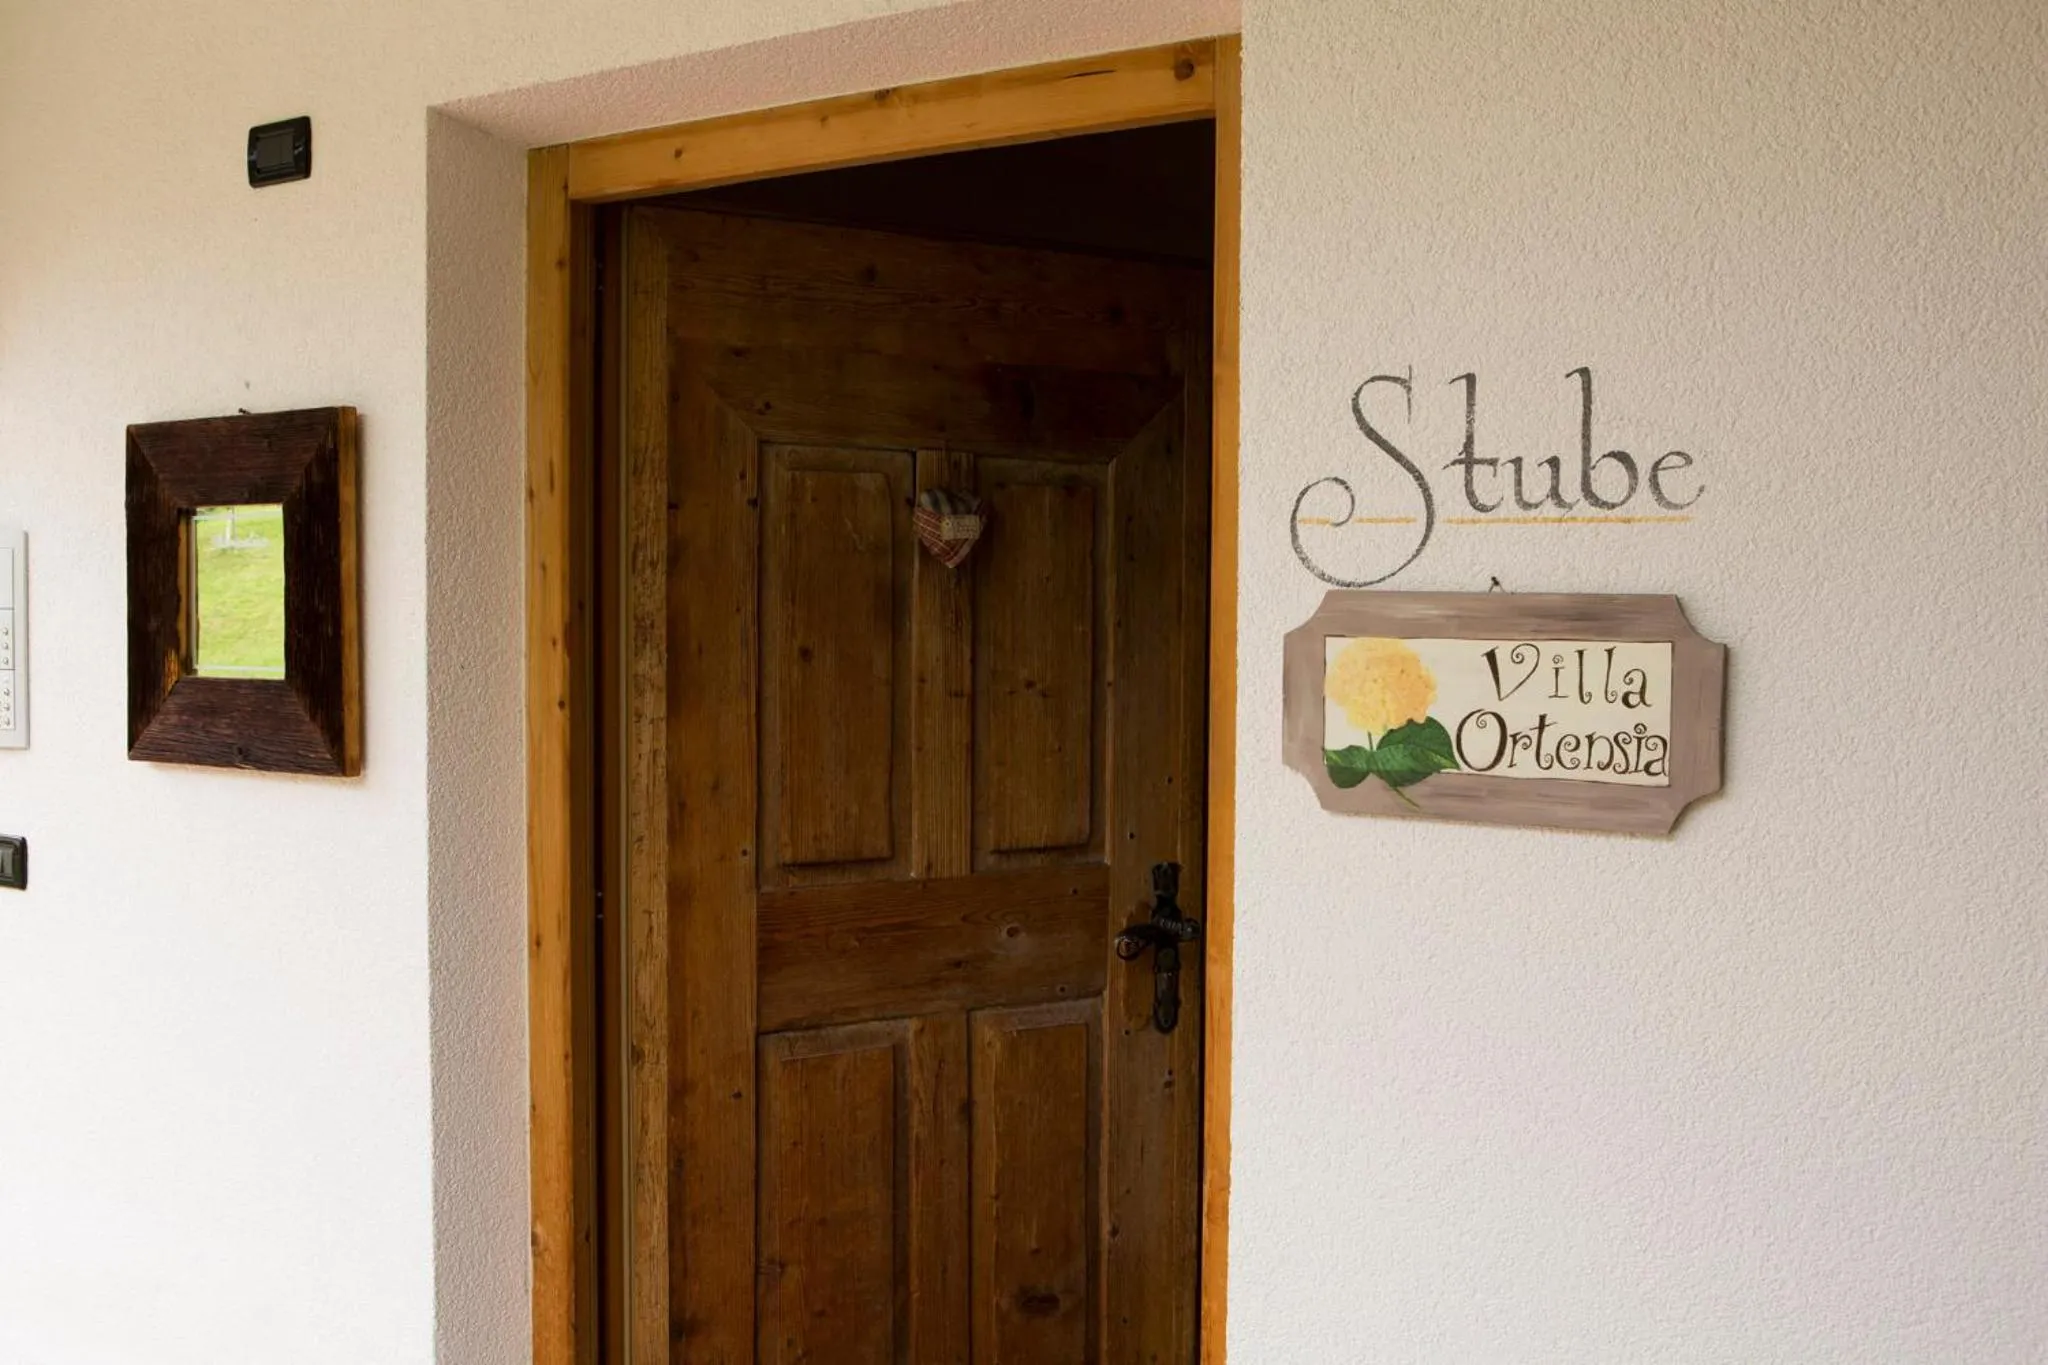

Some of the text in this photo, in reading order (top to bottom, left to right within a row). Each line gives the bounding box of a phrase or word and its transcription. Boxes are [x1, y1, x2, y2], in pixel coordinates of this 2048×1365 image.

[1290, 365, 1705, 587] Stube
[1482, 643, 1652, 709] Villa
[1456, 708, 1668, 777] Ortensia
